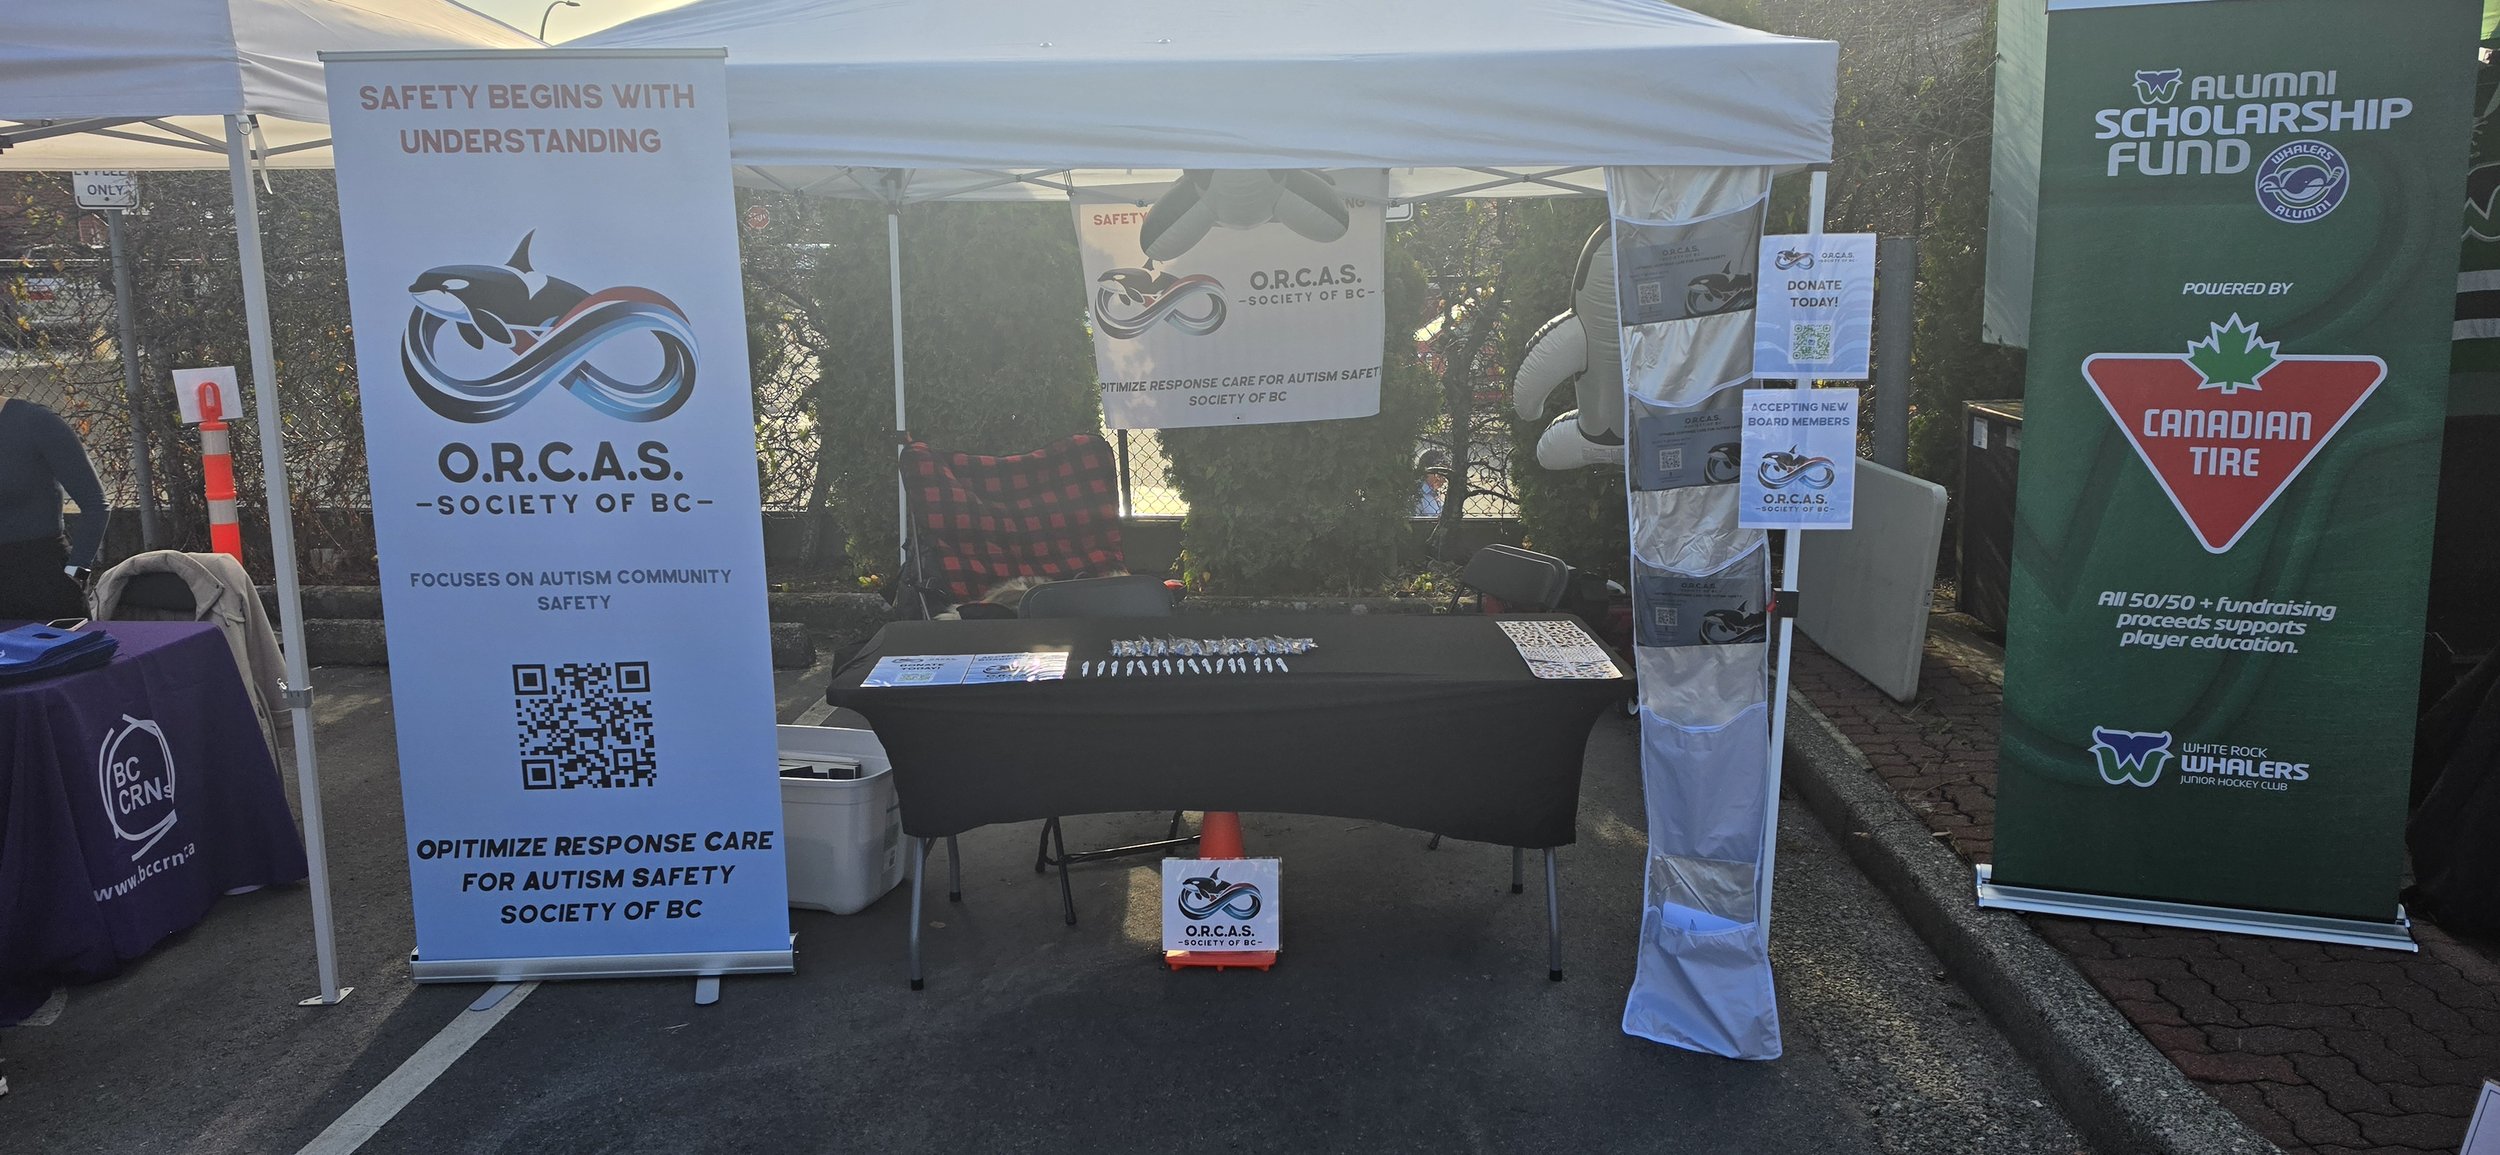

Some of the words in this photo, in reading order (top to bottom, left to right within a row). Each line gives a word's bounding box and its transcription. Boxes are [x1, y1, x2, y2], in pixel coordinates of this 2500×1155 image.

[359, 84, 479, 110] SAFETY
[487, 84, 603, 109] BEGINS
[611, 83, 695, 109] WITH
[2190, 70, 2337, 101] ALUMNI
[2095, 98, 2413, 139] SCHOLARSHIP
[400, 128, 661, 154] UNDERSTANDING
[2107, 138, 2251, 177] FUND
[2270, 144, 2335, 166] WHALERS
[87, 184, 124, 195] ONLY
[2274, 200, 2331, 219] ALUMNI
[1250, 264, 1362, 290] O.R.C.A.S.
[1787, 280, 1842, 291] DONATE
[2182, 282, 2266, 295] POWERED
[2268, 282, 2294, 295] BY
[1319, 290, 1338, 301] OF
[1790, 297, 1839, 308] TODAY!
[1100, 381, 1146, 392] PITIMIZE
[1149, 378, 1218, 391] RESPONSE
[1222, 375, 1256, 388] CARE
[1258, 374, 1285, 385] FOR
[1287, 370, 1338, 384] AUTISM
[1341, 366, 1382, 381] SAFET
[1188, 393, 1245, 406] SOCIETY
[1248, 392, 1267, 403] OF
[1268, 391, 1288, 402] BC
[1751, 402, 1819, 412] ACCEPTING
[1821, 402, 1849, 411] NEW
[1748, 417, 1789, 427] BOARD
[1791, 417, 1850, 427] MEMBERS
[2143, 408, 2312, 441] CANADIAN
[438, 440, 684, 483] O.R.C.A.S.
[2189, 446, 2260, 477] TIRE
[595, 493, 636, 513] OF
[1764, 494, 1828, 504] O.R.C.A.S.
[410, 572, 500, 587] FOCUSES
[505, 571, 534, 586] ON
[539, 570, 612, 586] AUTISM
[617, 569, 732, 585] COMMUNITY
[537, 595, 611, 611] SAFETY
[2098, 591, 2127, 607] All
[2128, 592, 2195, 611] 50/50
[2215, 596, 2337, 622] fundraising
[2116, 613, 2212, 631] proceeds
[2214, 619, 2307, 636] supports
[2120, 630, 2189, 649] player
[2190, 633, 2299, 654] education.
[2183, 742, 2228, 756] WHITE
[2231, 746, 2268, 758] ROCK
[112, 756, 141, 788] BC
[2180, 754, 2310, 781] WHALERS
[2180, 775, 2216, 786] JUNIOR
[2218, 778, 2259, 789] HOCKEY
[2261, 780, 2288, 791] CLUB
[416, 837, 548, 860] OPITIMIZE
[554, 833, 697, 857] RESPONSE
[704, 831, 774, 852] CARE
[462, 872, 515, 893] FOR
[522, 869, 625, 891] AUTISM
[632, 865, 736, 888] SAFETY
[500, 902, 617, 924] SOCIETY
[623, 901, 660, 921] OF
[666, 899, 703, 919] BC
[1185, 925, 1255, 937] O.R.C.A.S.
